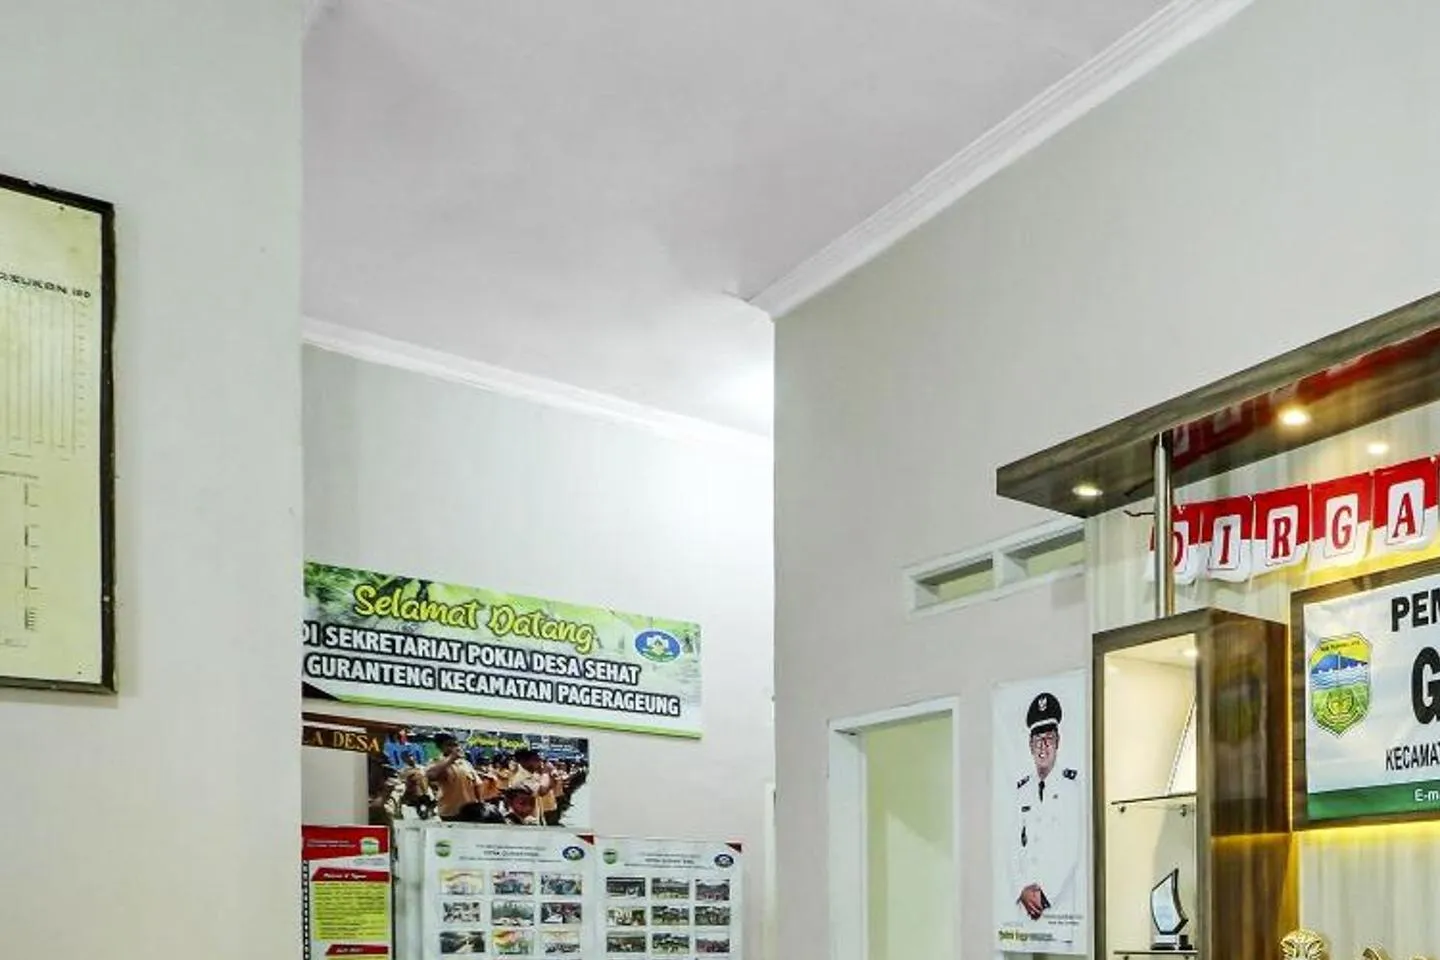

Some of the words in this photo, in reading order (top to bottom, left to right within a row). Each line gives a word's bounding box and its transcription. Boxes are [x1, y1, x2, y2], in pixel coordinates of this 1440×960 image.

[353, 584, 478, 629] Selamat
[488, 605, 594, 654] Datang
[306, 654, 433, 688] GURANTENG
[440, 670, 552, 700] KECAMATAN
[558, 684, 680, 715] PAGERAGEUNG
[325, 626, 462, 661] SEKRETARIAT
[532, 652, 580, 677] DESA
[584, 659, 640, 684] SEHAT
[333, 731, 380, 752] DESA
